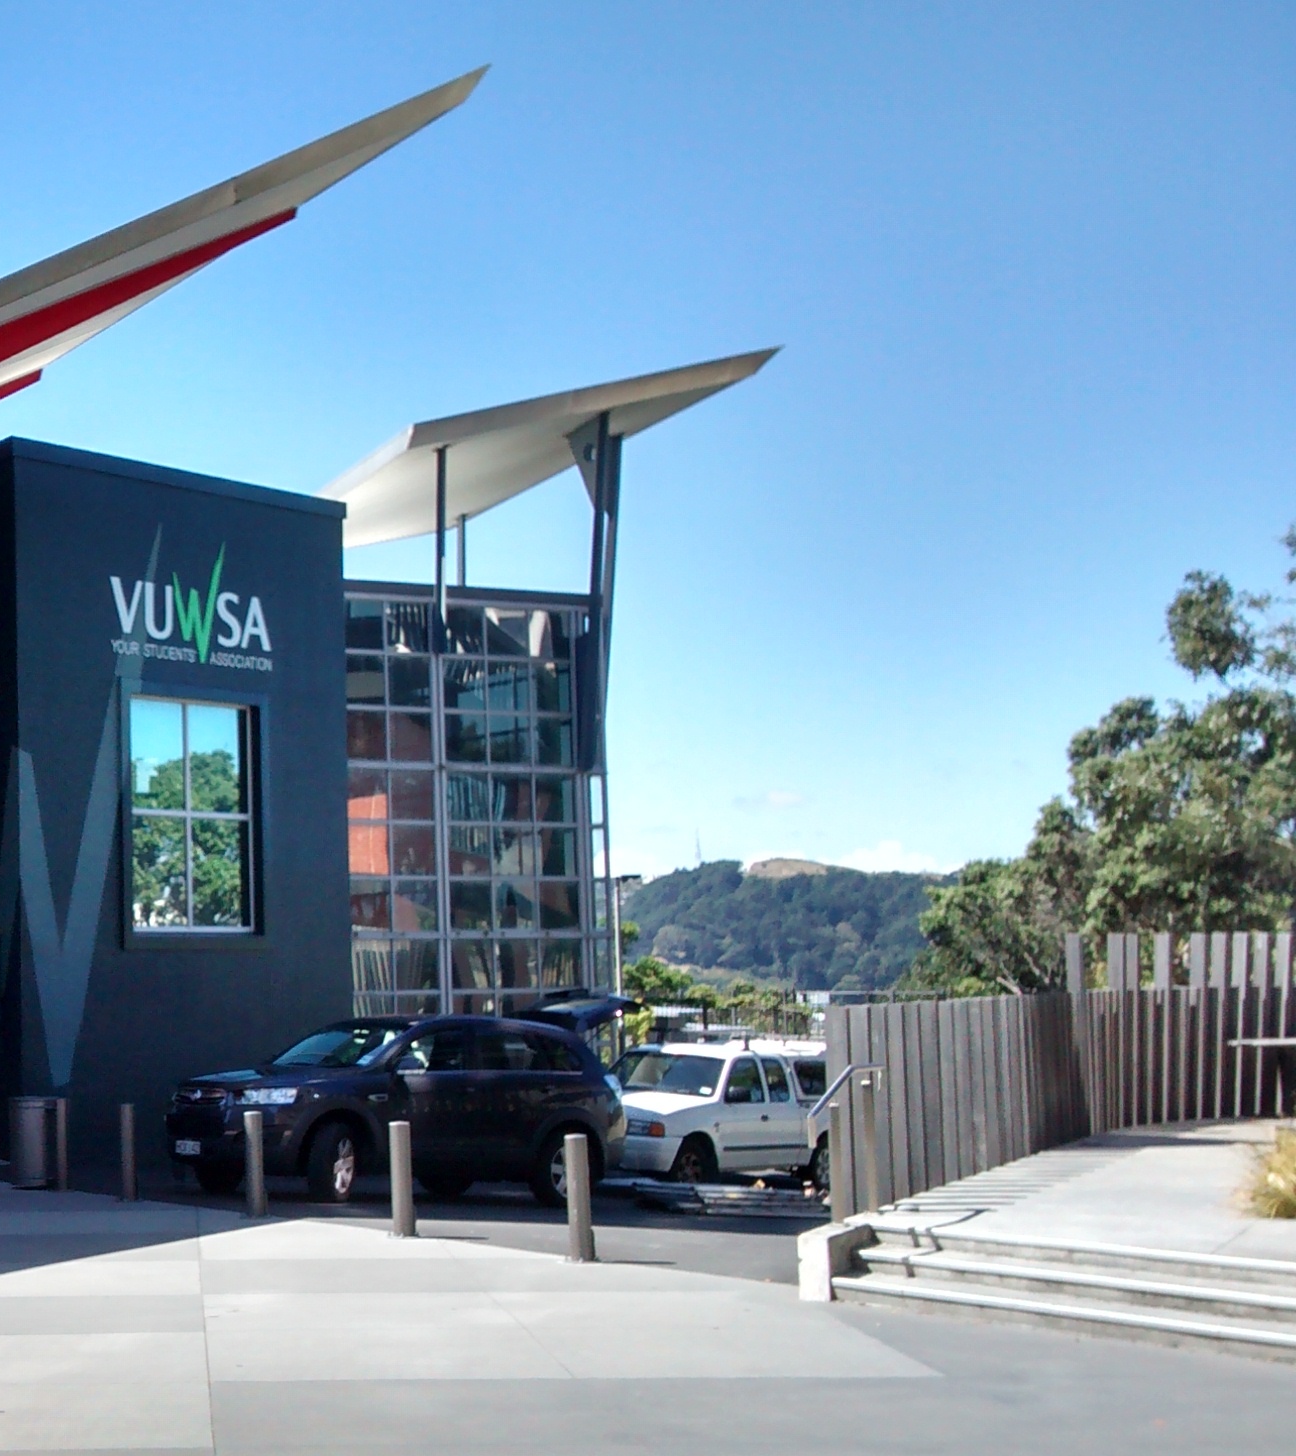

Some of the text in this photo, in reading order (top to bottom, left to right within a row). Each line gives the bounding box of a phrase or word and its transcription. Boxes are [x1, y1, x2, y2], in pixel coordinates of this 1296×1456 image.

[109, 540, 272, 664] VUWSA
[111, 639, 273, 672] YOUR STUDENTS ASSOCIATION
